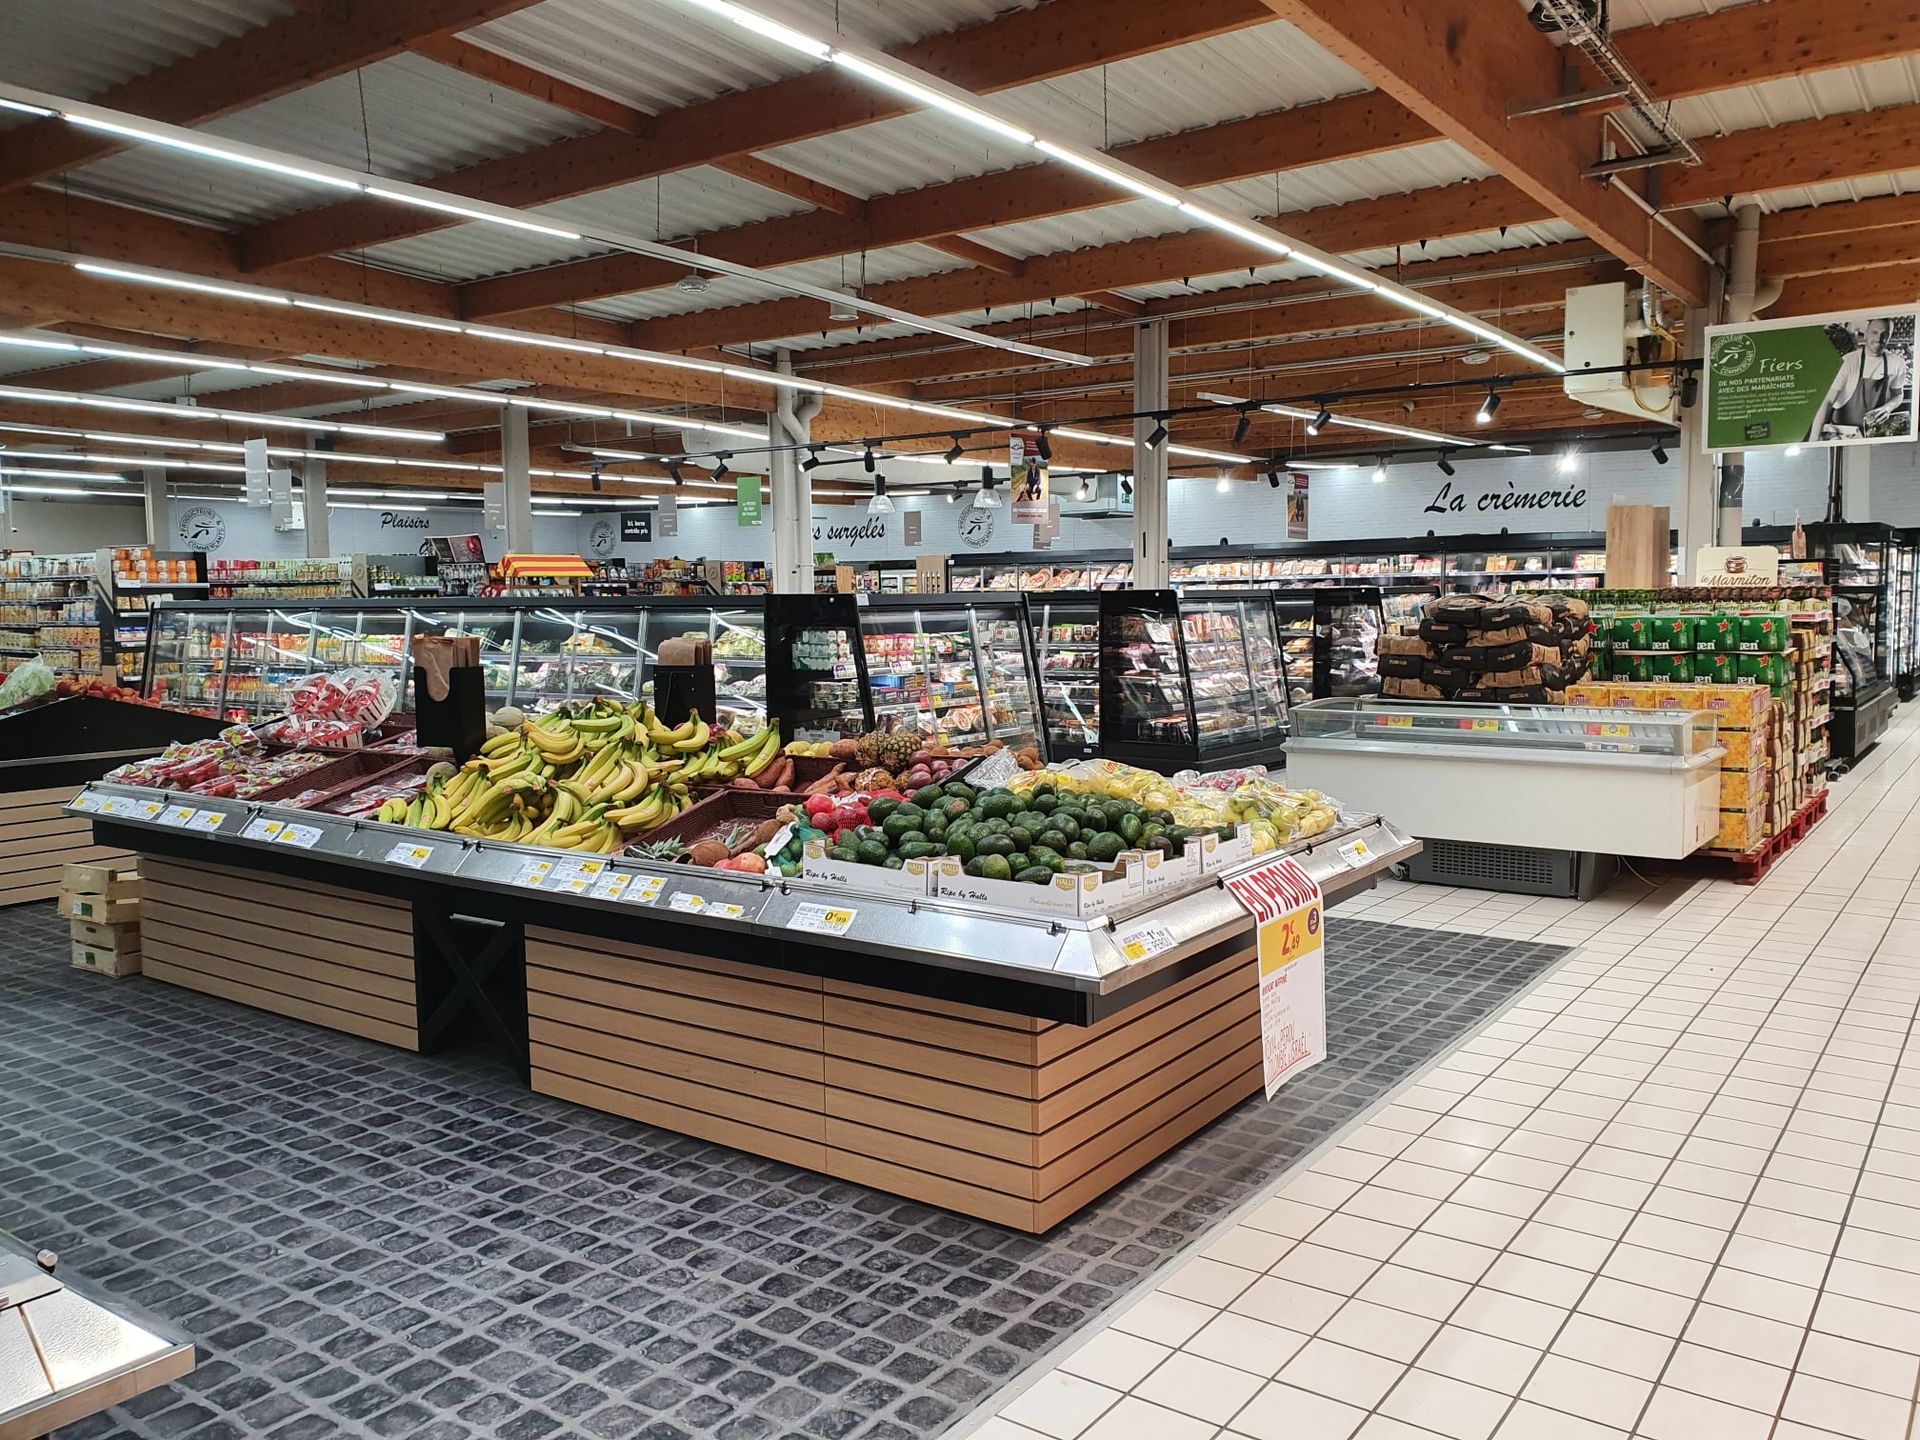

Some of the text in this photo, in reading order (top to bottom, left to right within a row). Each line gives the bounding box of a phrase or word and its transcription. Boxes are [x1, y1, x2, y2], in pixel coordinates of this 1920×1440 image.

[1759, 357, 1803, 374] Fiers
[1744, 374, 1795, 384] PARTENARIATS
[1423, 481, 1587, 513] La crèmerie
[380, 511, 430, 529] Plaisirs
[812, 516, 886, 547] s surgelés
[1707, 574, 1772, 586] Marmiton
[804, 869, 848, 882] Ripe by Halls
[940, 887, 988, 901] Ripe by Halls
[1230, 860, 1318, 923] EN PROMO
